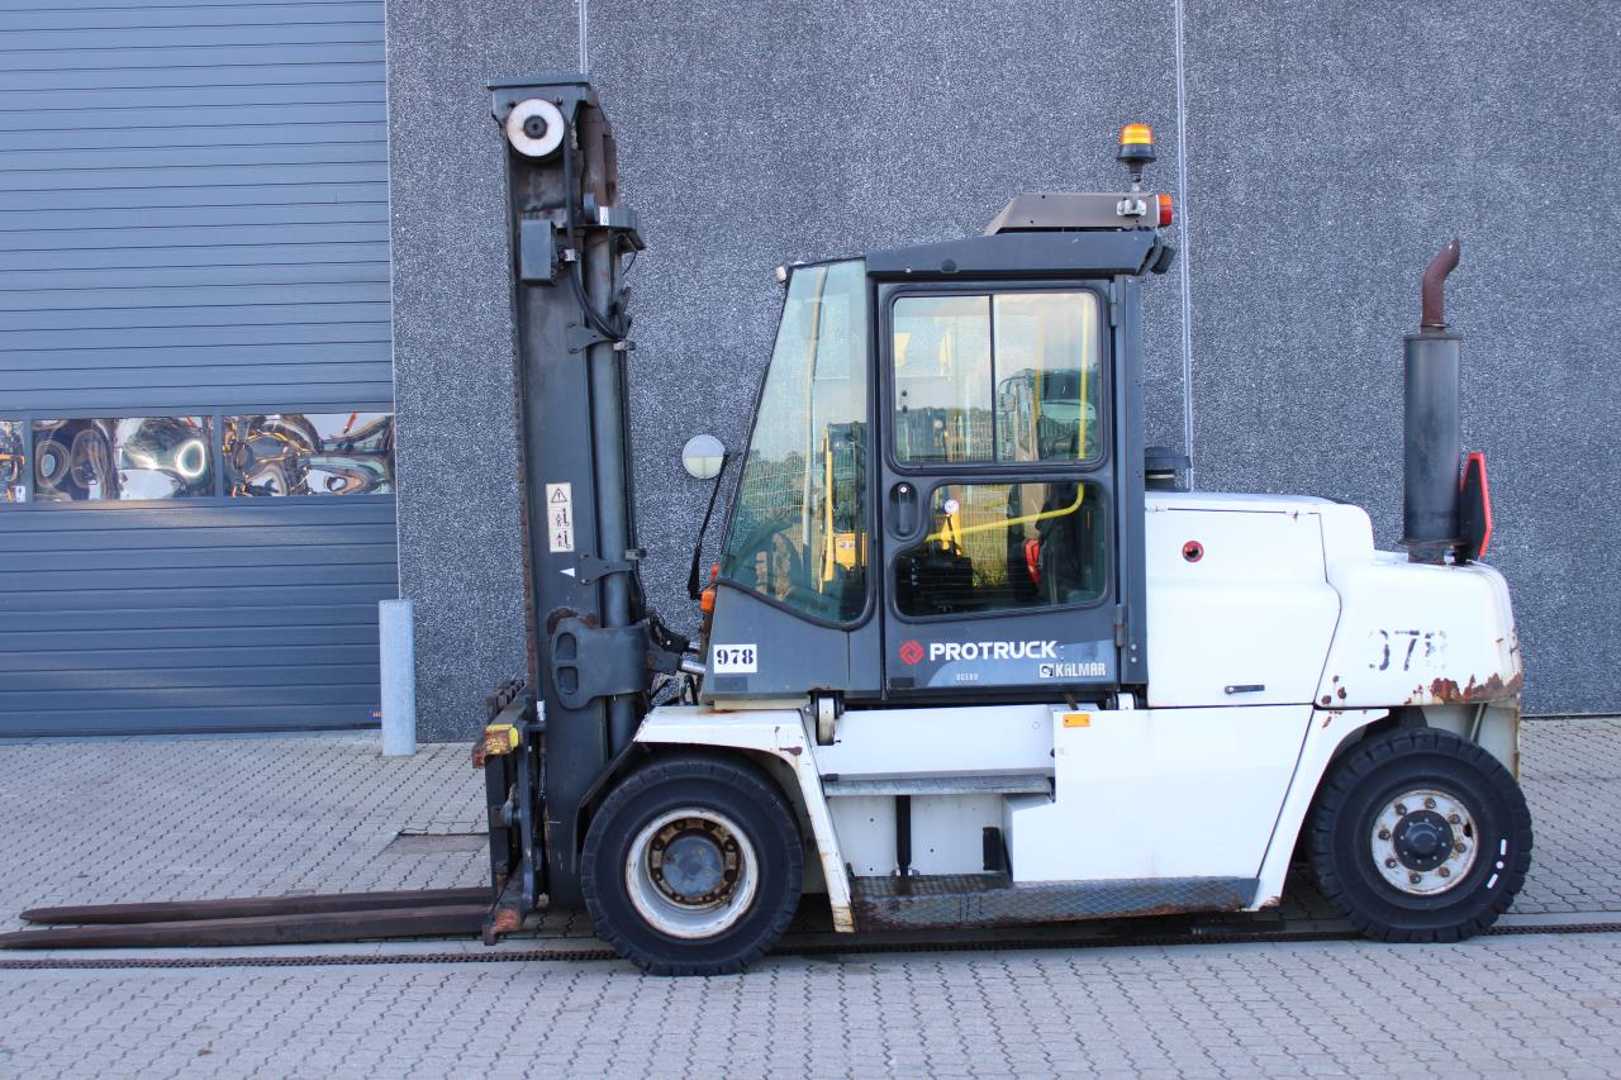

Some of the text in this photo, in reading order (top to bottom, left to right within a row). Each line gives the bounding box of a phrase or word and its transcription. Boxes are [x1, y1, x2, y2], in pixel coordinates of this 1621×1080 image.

[716, 649, 754, 665] 978
[929, 640, 1058, 661] PROTRUCK
[1055, 662, 1106, 677] KALMAR
